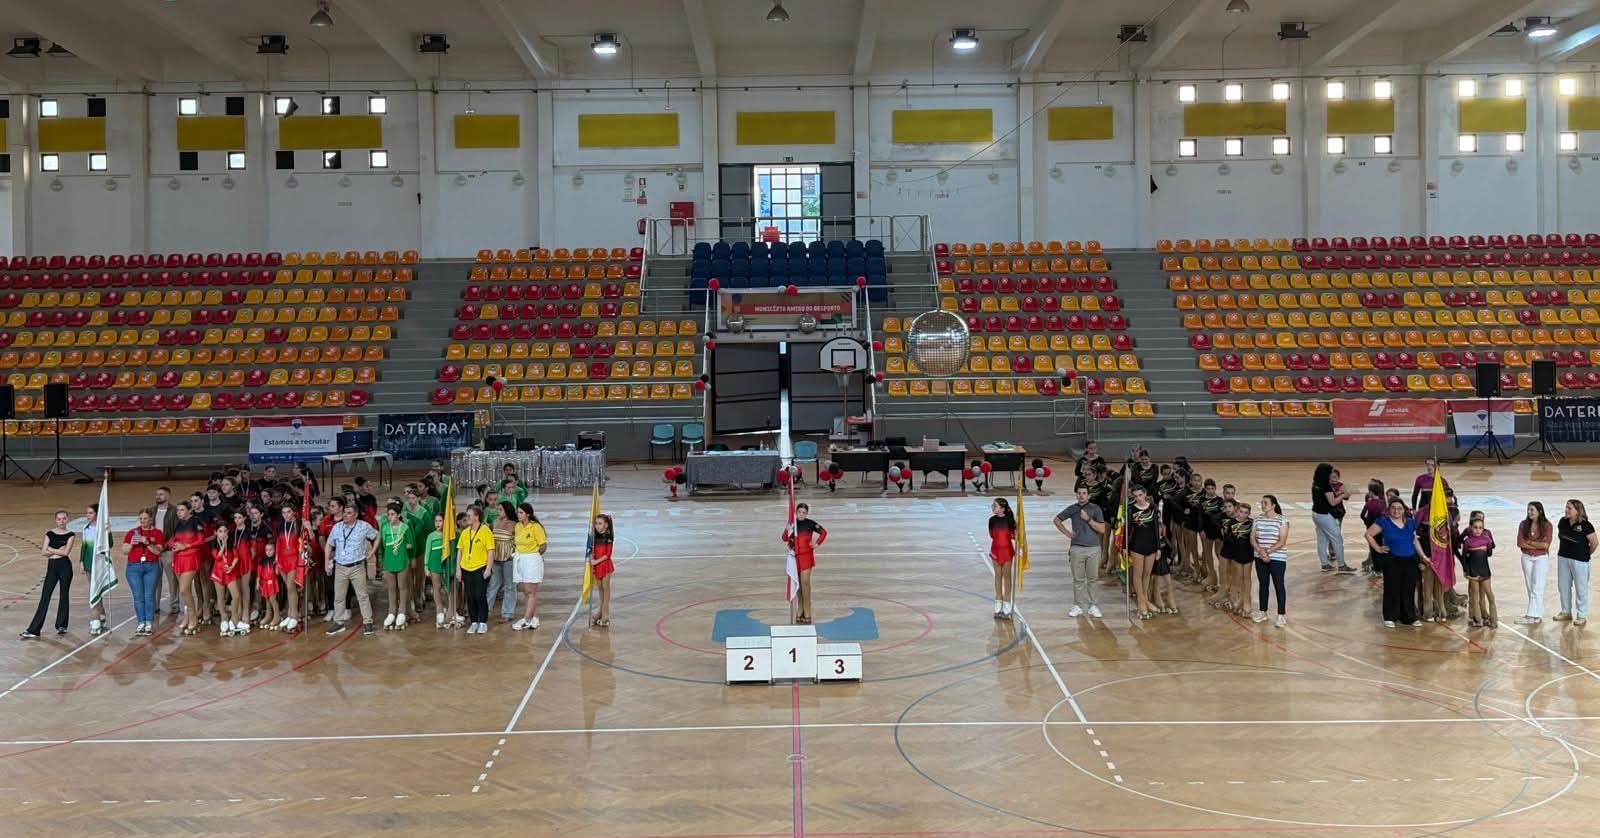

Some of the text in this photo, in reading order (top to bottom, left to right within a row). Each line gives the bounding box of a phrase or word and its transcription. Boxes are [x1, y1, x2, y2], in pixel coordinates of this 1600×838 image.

[743, 655, 755, 671] 2
[788, 647, 797, 663] 1
[834, 658, 845, 674] 3
